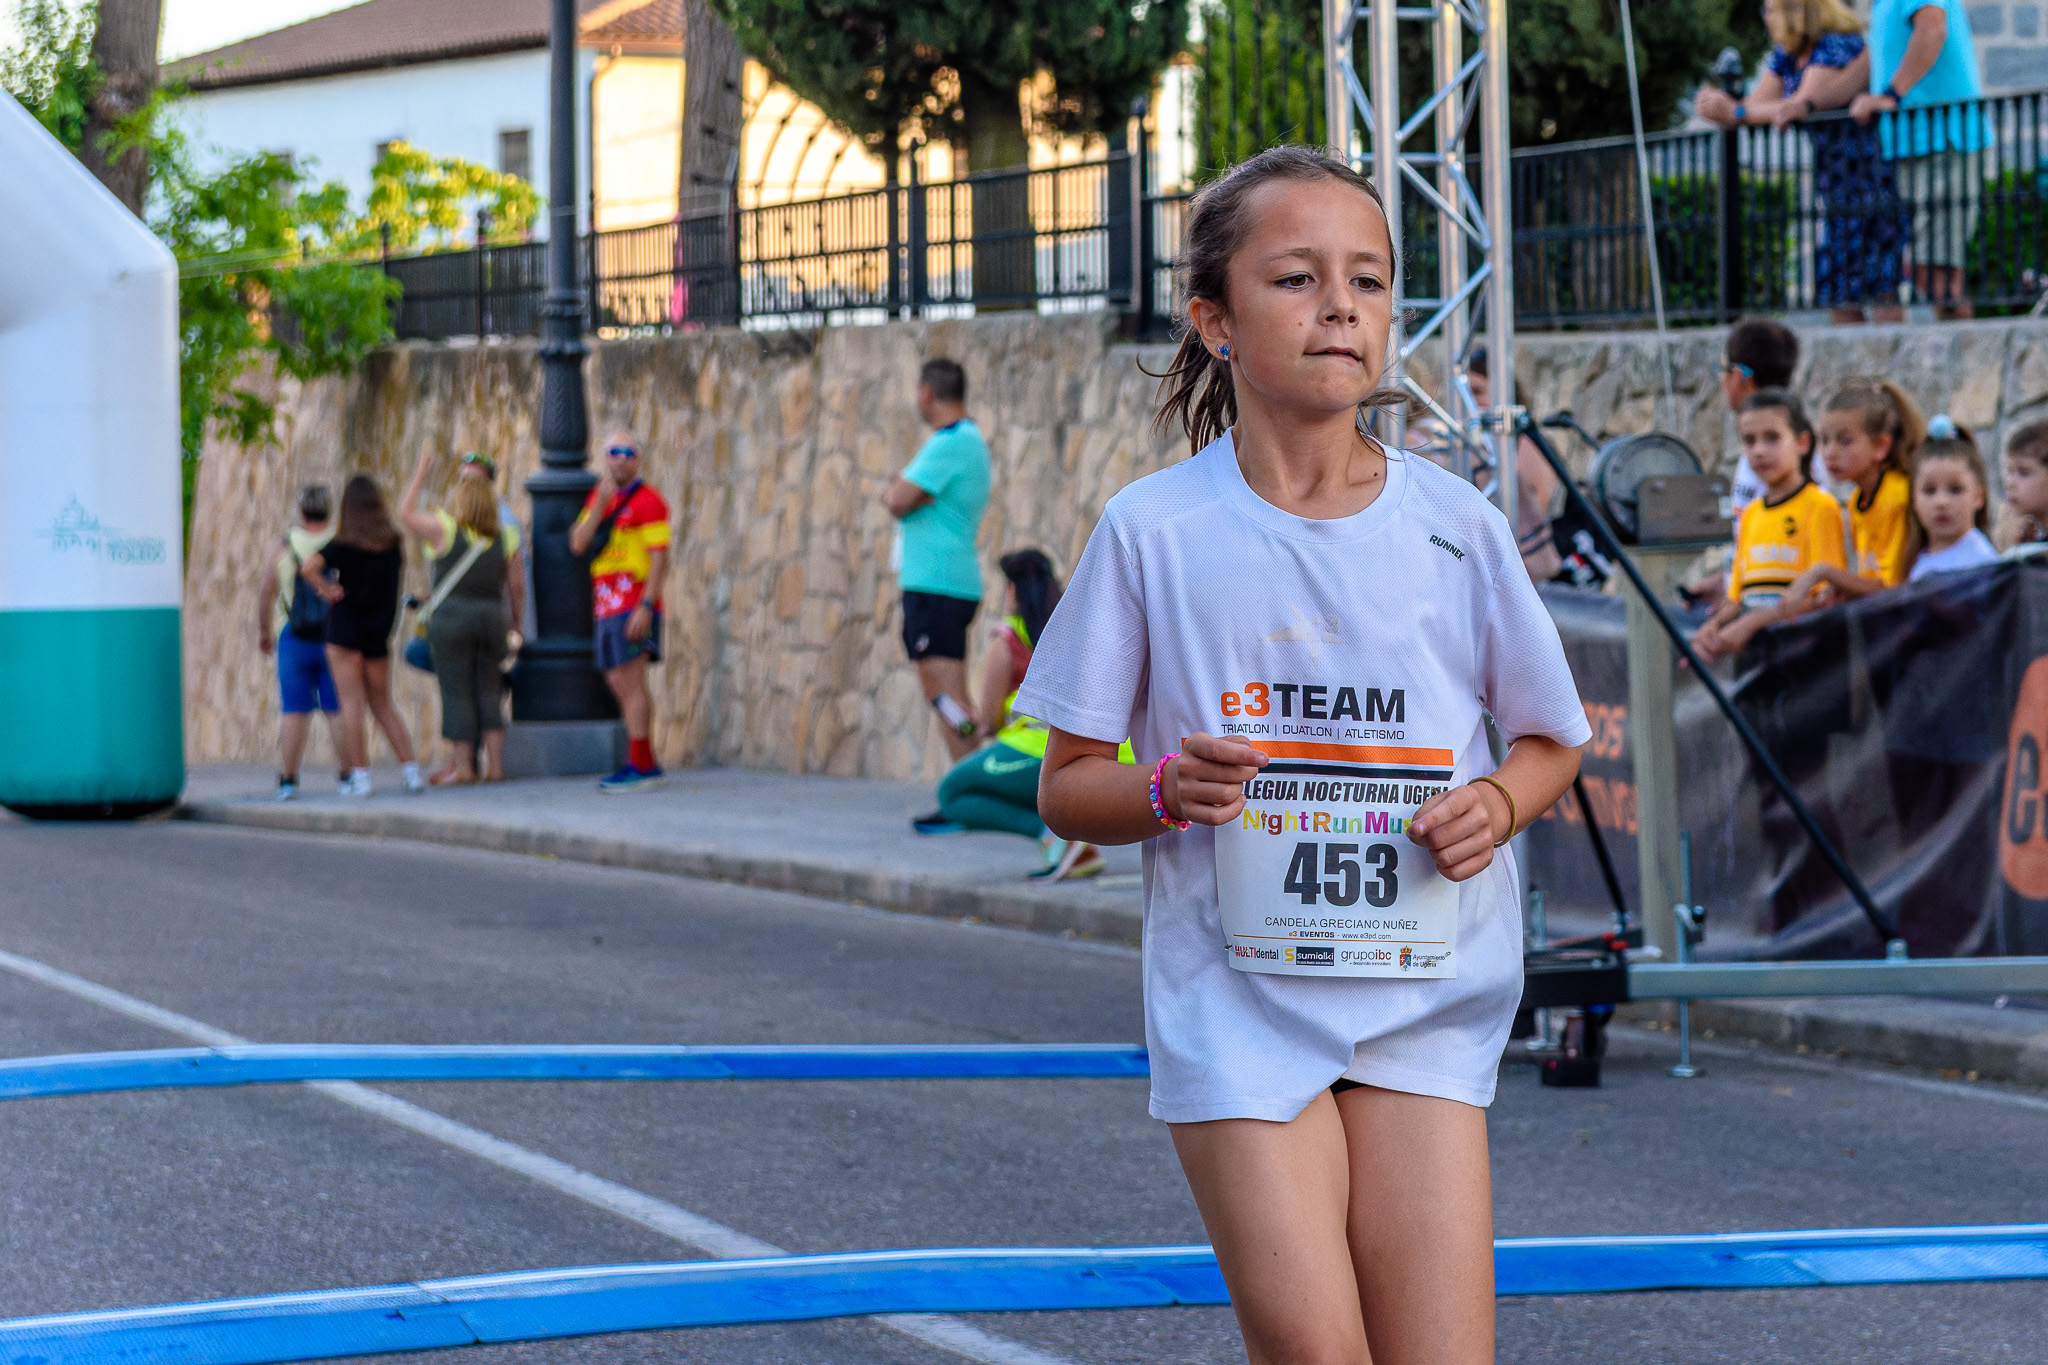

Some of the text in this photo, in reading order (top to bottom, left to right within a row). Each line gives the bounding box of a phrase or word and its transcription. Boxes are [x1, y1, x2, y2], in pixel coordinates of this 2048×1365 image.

[1429, 534, 1465, 562] RUNNEK
[1221, 724, 1405, 740] TRIATLON DUATLON ATLETISMO
[1302, 781, 1399, 804] NOCTURNA
[1284, 842, 1398, 908] 453
[1265, 916, 1418, 930] CANDELA GRECIANO NUÑEZ
[1342, 932, 1391, 940] www.e3pd.com
[1341, 949, 1392, 962] grupoibc
